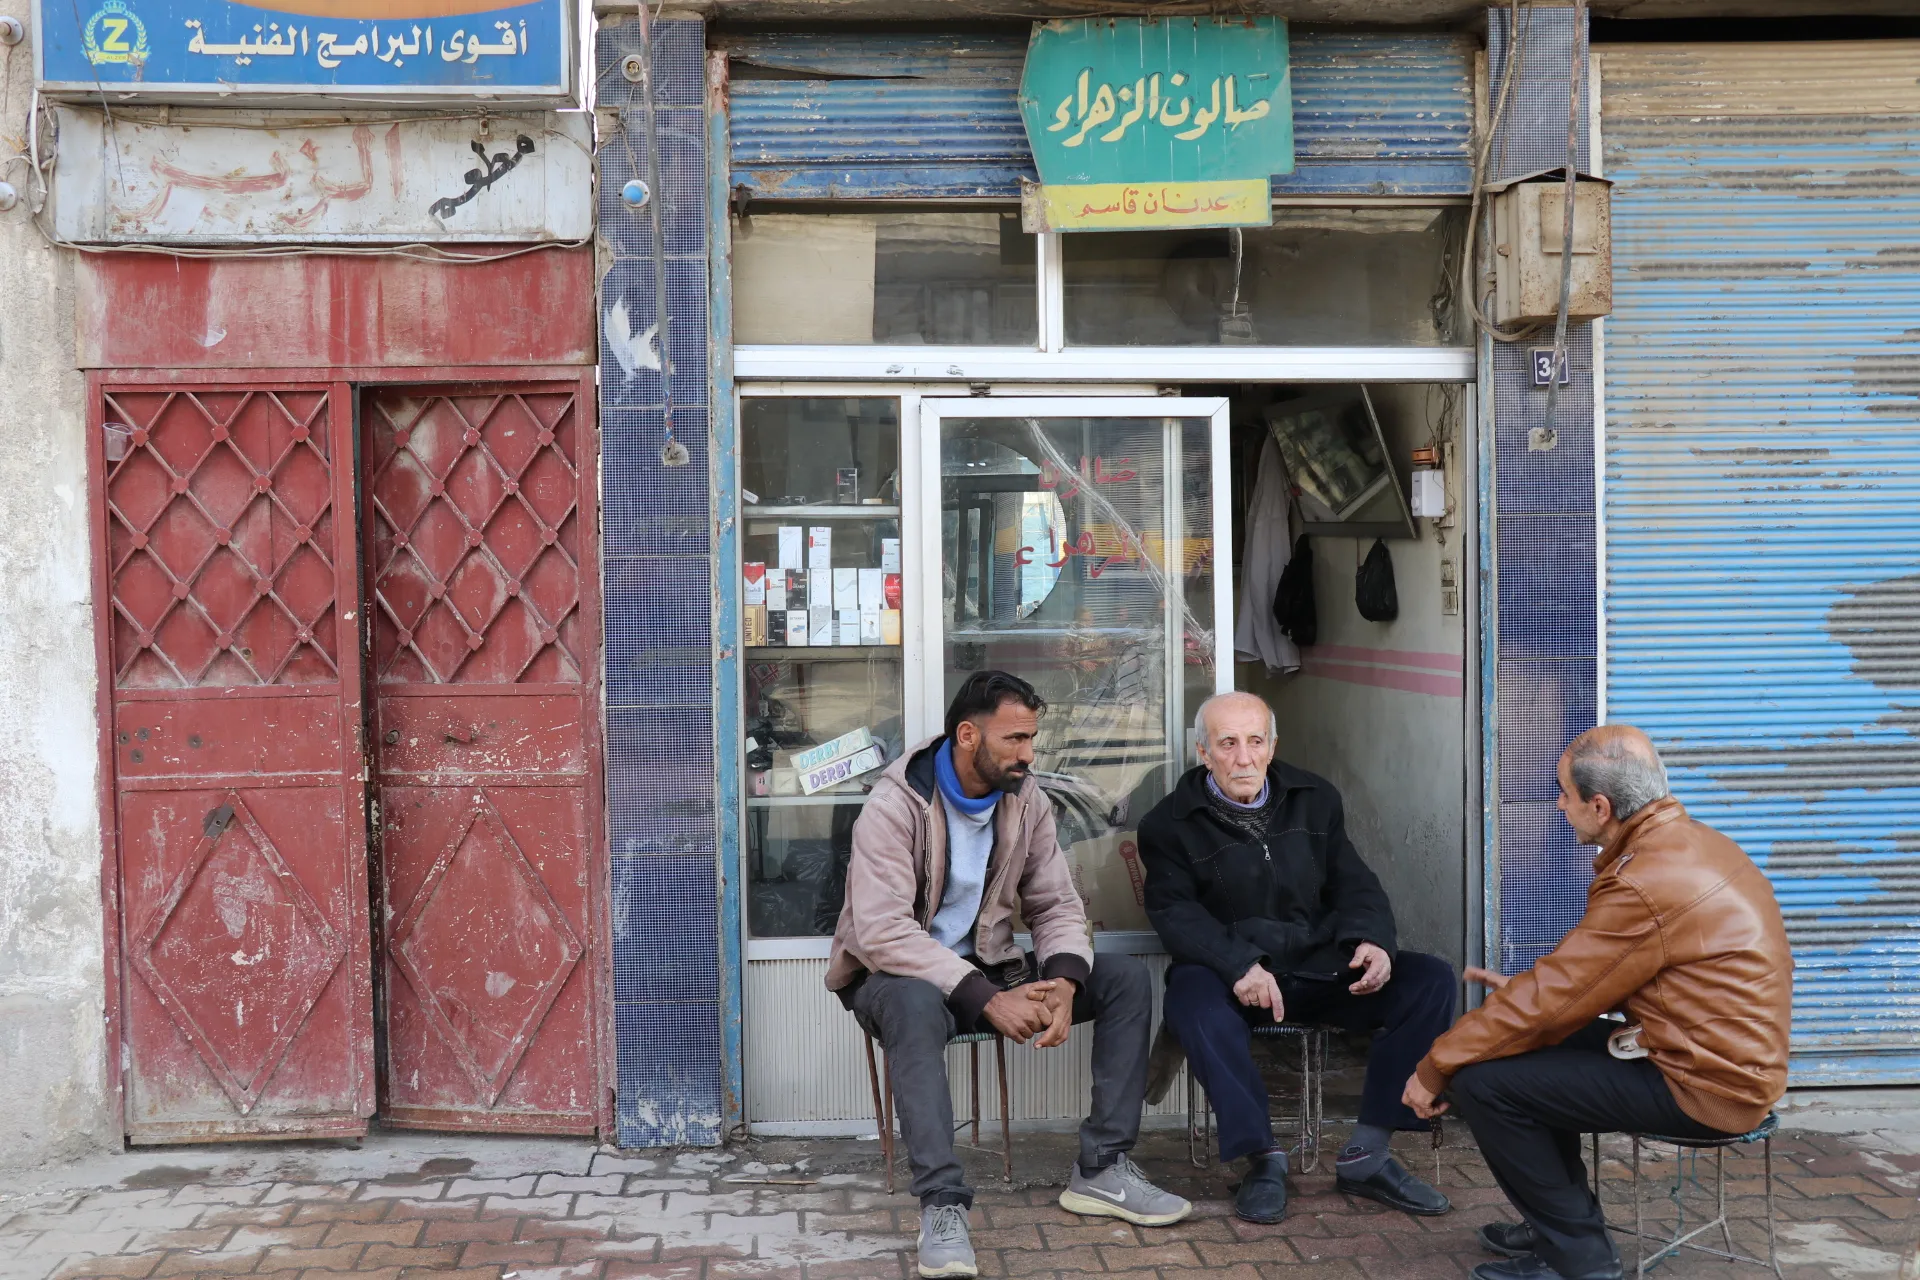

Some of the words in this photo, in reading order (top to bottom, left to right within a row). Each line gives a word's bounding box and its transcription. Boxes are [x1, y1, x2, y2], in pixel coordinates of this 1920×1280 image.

[103, 18, 129, 51] Z
[184, 19, 308, 66] الفنية
[317, 24, 433, 68] البرامج
[441, 19, 527, 64] أقوى
[1047, 68, 1161, 147] الزهراء
[1159, 72, 1271, 141] صالون
[1074, 187, 1139, 218] قاسم
[1143, 188, 1229, 215] عدنان
[800, 740, 841, 769] DERBY
[809, 760, 852, 789] DERBY
